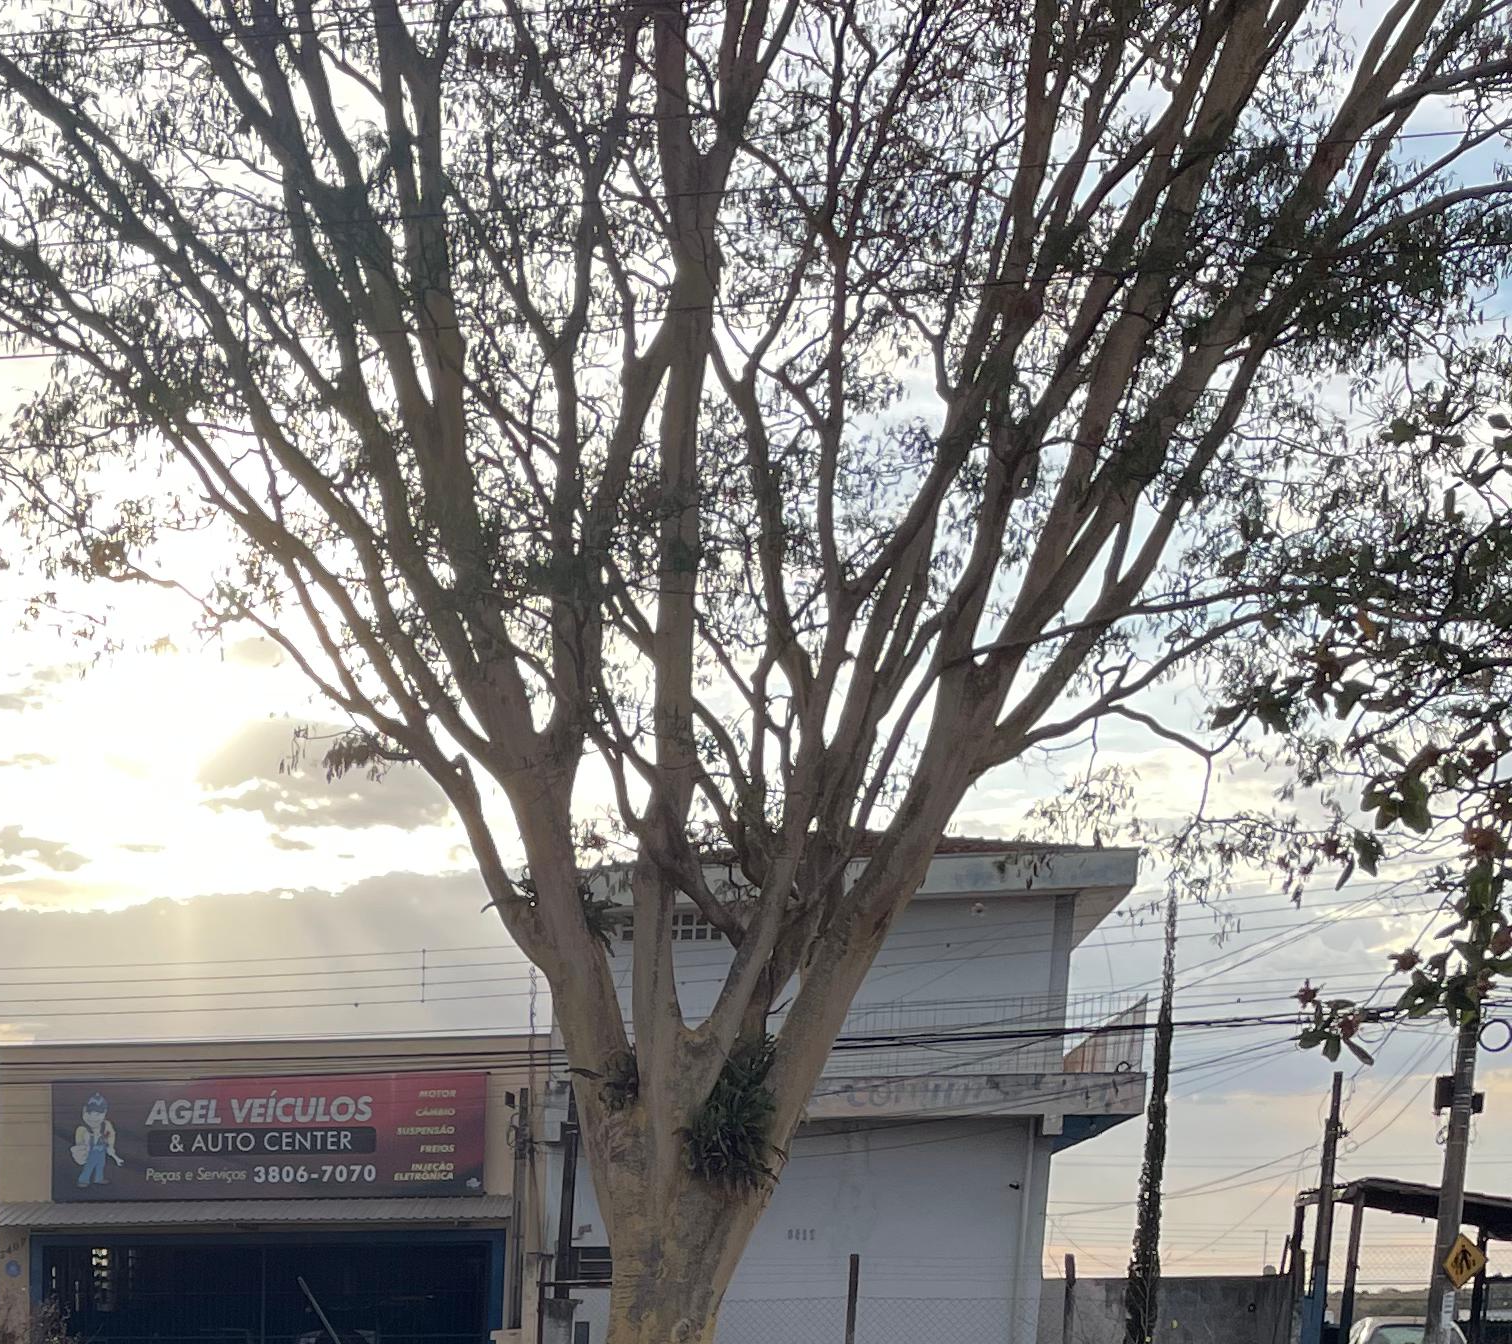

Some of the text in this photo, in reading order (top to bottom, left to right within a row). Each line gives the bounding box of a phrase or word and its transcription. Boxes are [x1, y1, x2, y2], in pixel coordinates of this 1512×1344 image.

[419, 1089, 457, 1098] MOTOR
[145, 1090, 373, 1126] AGEL VEÍCULOS
[397, 1124, 455, 1136] SUSPENSÃO
[169, 1131, 352, 1153] & AUTO CENTER
[420, 1144, 455, 1153] FREIOS
[411, 1161, 454, 1172] INJEÇÃO
[146, 1167, 247, 1184] Peças e Serviços
[253, 1164, 376, 1183] 3806-7070
[393, 1171, 453, 1181] ELETRÔNICA
